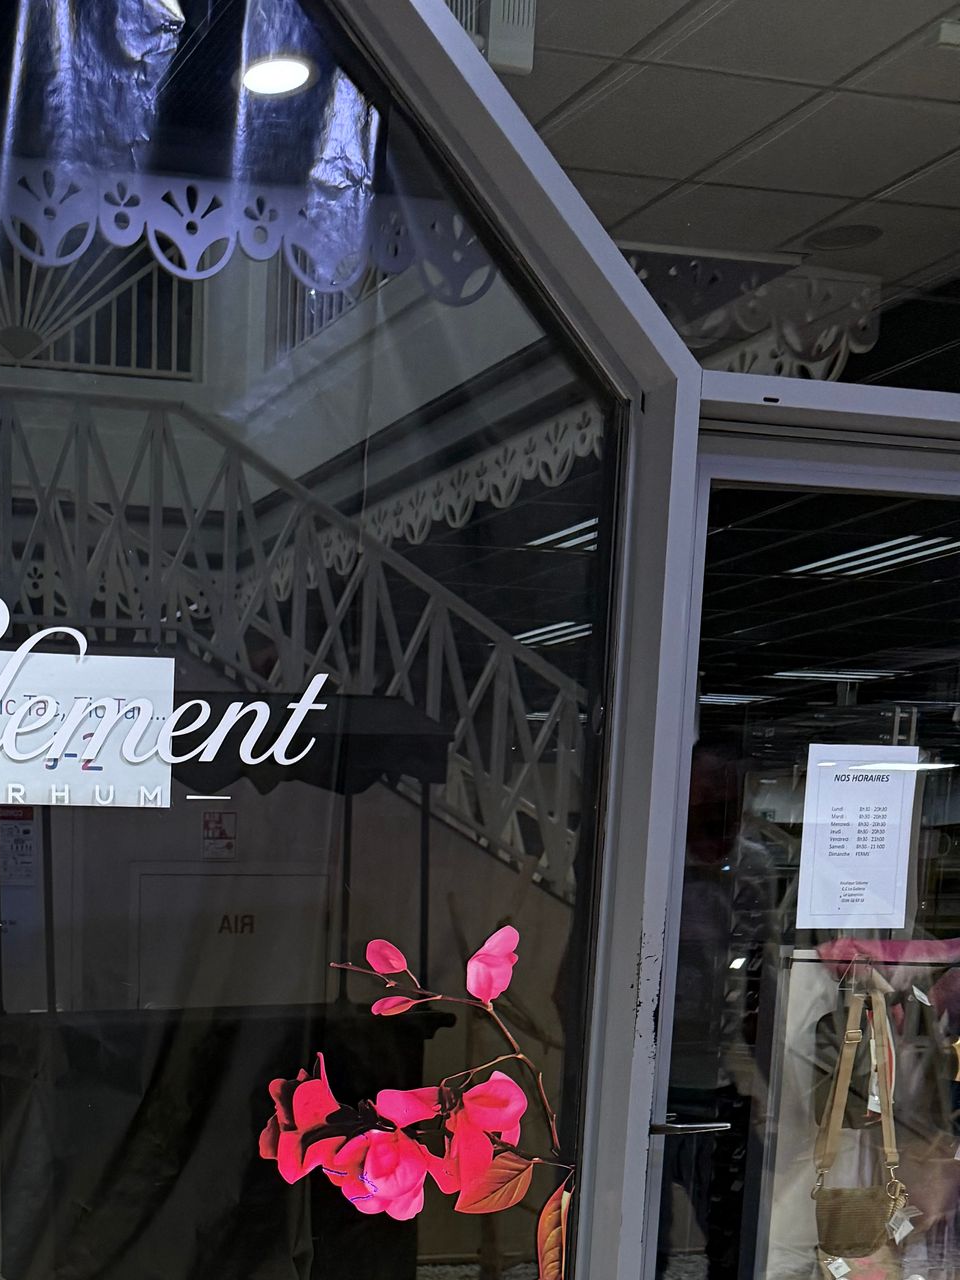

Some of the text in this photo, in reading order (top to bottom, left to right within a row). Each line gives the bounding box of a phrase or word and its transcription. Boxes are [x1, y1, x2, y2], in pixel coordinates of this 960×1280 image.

[834, 774, 890, 783] NOS HORAIRES
[7, 783, 162, 806] RHUM
